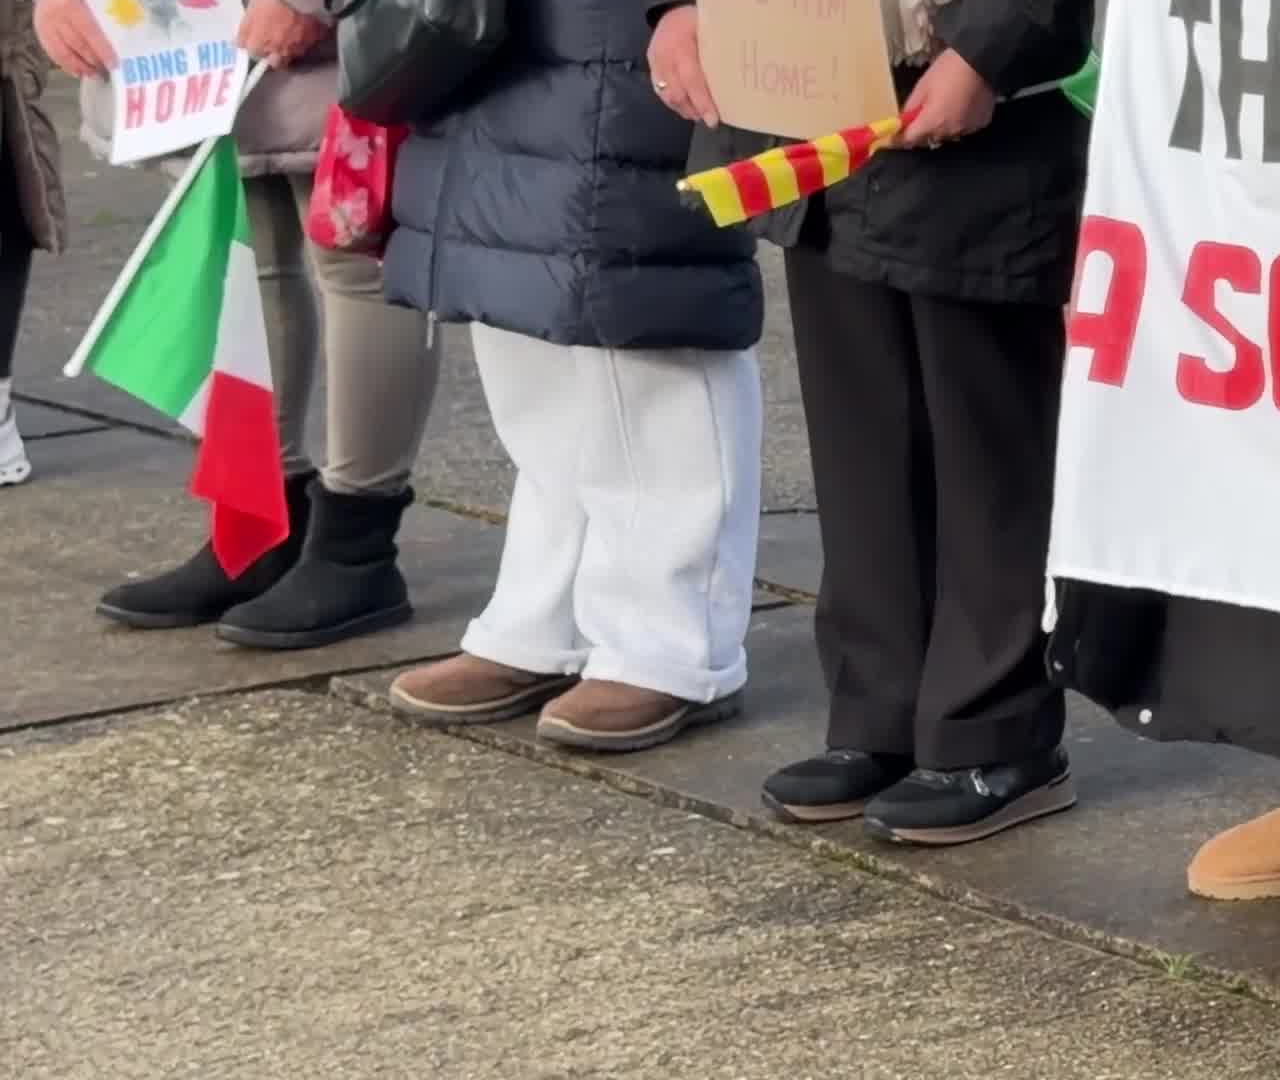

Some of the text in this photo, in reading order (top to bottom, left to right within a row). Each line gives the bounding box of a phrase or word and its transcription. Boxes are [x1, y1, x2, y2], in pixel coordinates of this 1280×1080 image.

[122, 48, 187, 84] BRING
[124, 67, 235, 130] HOME
[1067, 216, 1147, 388] A
